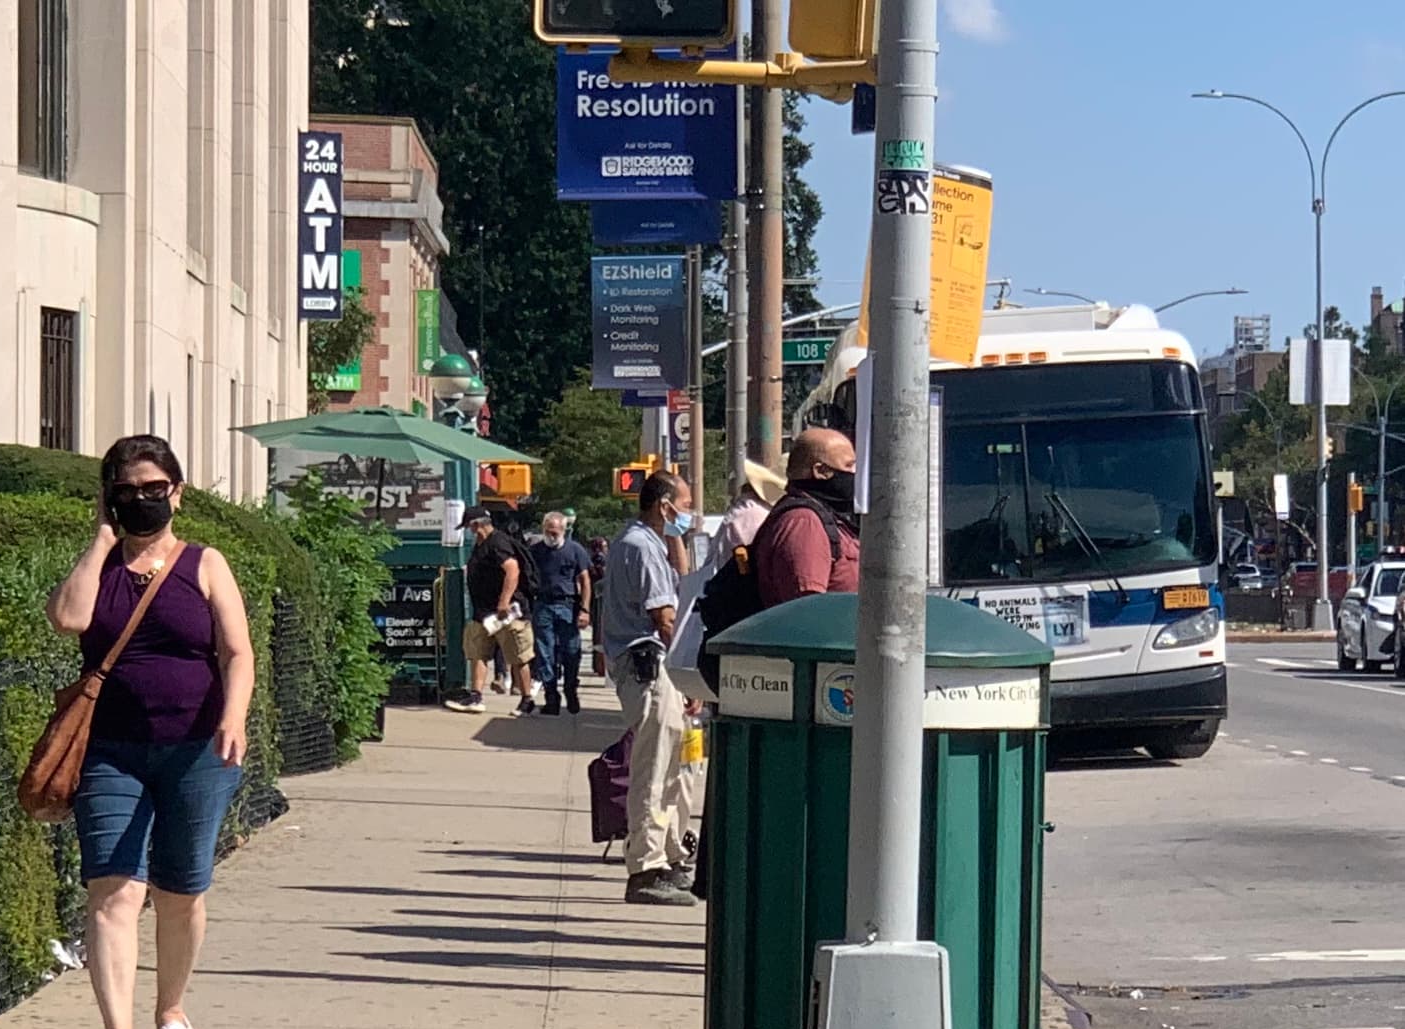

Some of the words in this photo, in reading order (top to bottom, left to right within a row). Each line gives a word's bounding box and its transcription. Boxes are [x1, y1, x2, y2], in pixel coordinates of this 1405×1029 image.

[577, 93, 715, 118] Resolution
[305, 140, 336, 161] 24
[303, 161, 338, 174] HOUR
[622, 155, 694, 167] RIDGEWOOD
[622, 167, 665, 176] SAVINGS
[665, 167, 694, 176] BANK
[934, 182, 974, 202] llection
[302, 177, 338, 290] ATM
[602, 264, 672, 280] EZShield
[621, 287, 673, 297] Restoration
[610, 304, 632, 313] Dark
[610, 315, 659, 325] Monitoring
[610, 331, 639, 340] Credit
[610, 343, 659, 353] Monitoring
[797, 343, 819, 359] 108
[402, 586, 432, 601] Avs
[998, 597, 1037, 606] ANIMALS
[730, 673, 747, 693] City
[751, 675, 788, 692] Clean
[935, 685, 969, 700] New
[974, 684, 1006, 700] York
[1009, 686, 1026, 704] City
